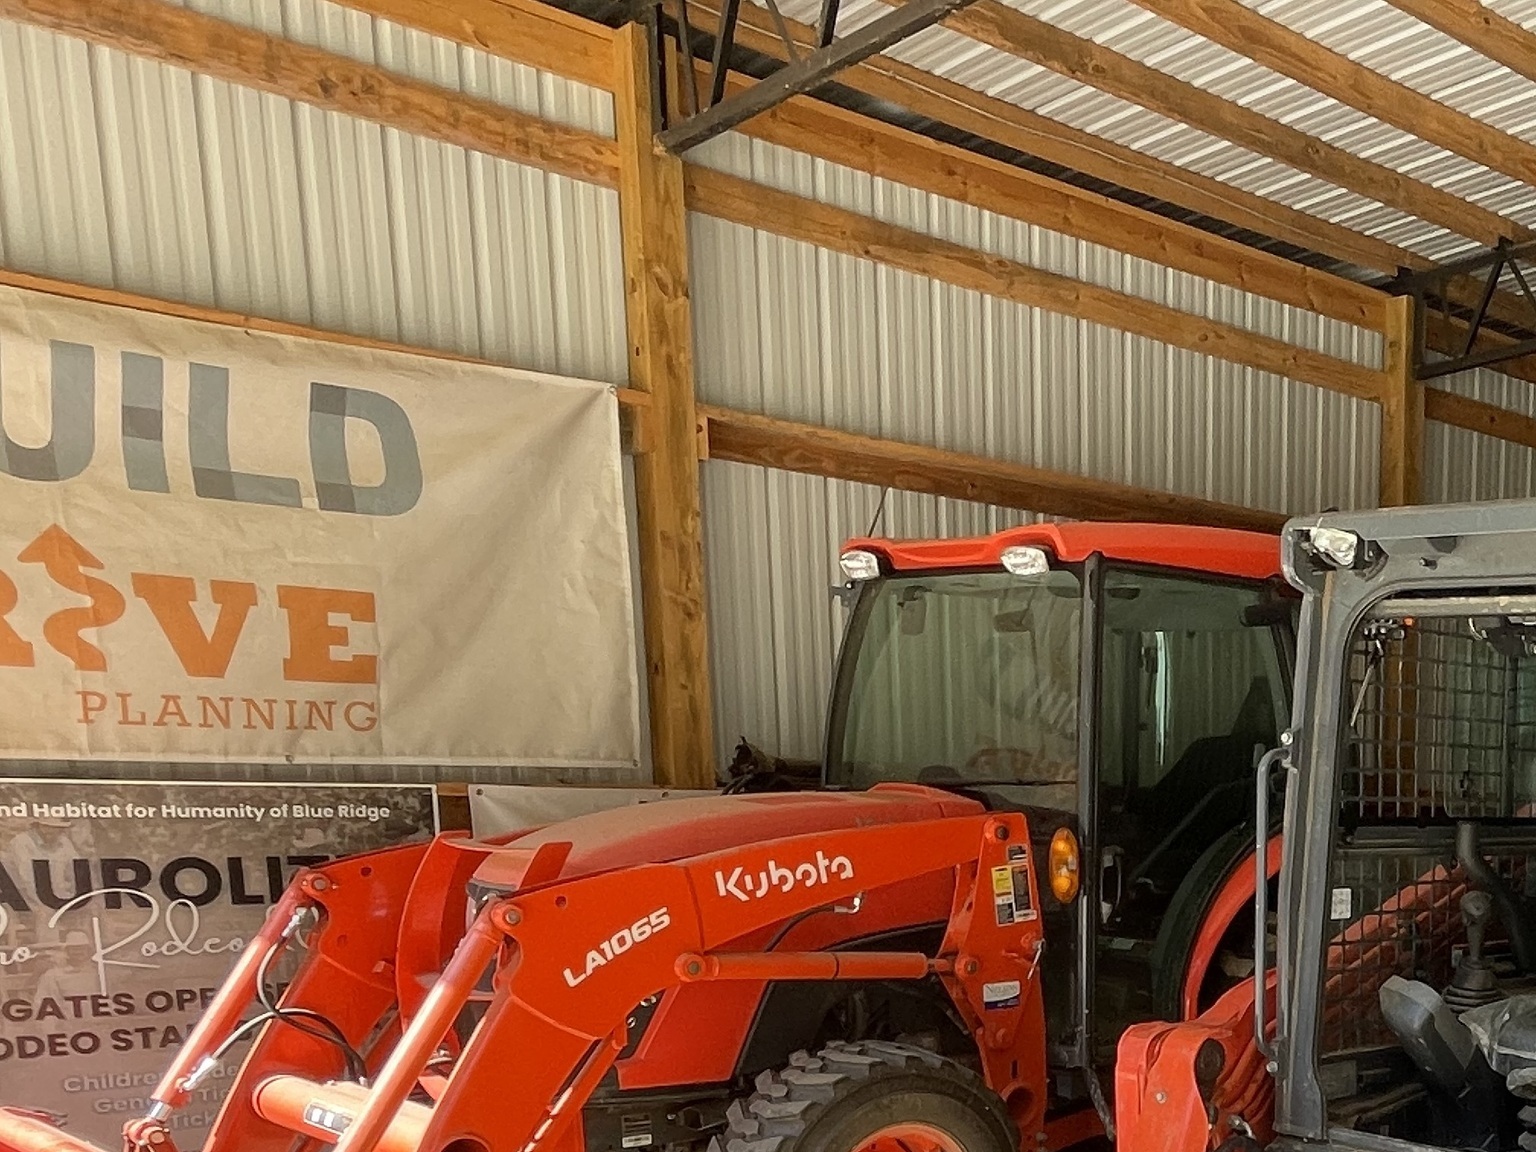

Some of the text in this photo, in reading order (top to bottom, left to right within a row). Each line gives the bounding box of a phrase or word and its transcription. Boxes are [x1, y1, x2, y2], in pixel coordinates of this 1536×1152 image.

[76, 690, 378, 733] PLANNING
[33, 803, 122, 818] Habitat
[126, 803, 156, 818] for
[161, 804, 263, 822] Humanity
[269, 803, 288, 818] of
[292, 804, 334, 818] Blue
[338, 804, 391, 822] Ridge
[714, 850, 854, 902] Kubota
[563, 907, 671, 988] LA1065
[2, 988, 221, 1022] GATES OPE
[64, 1071, 161, 1092] Childre
